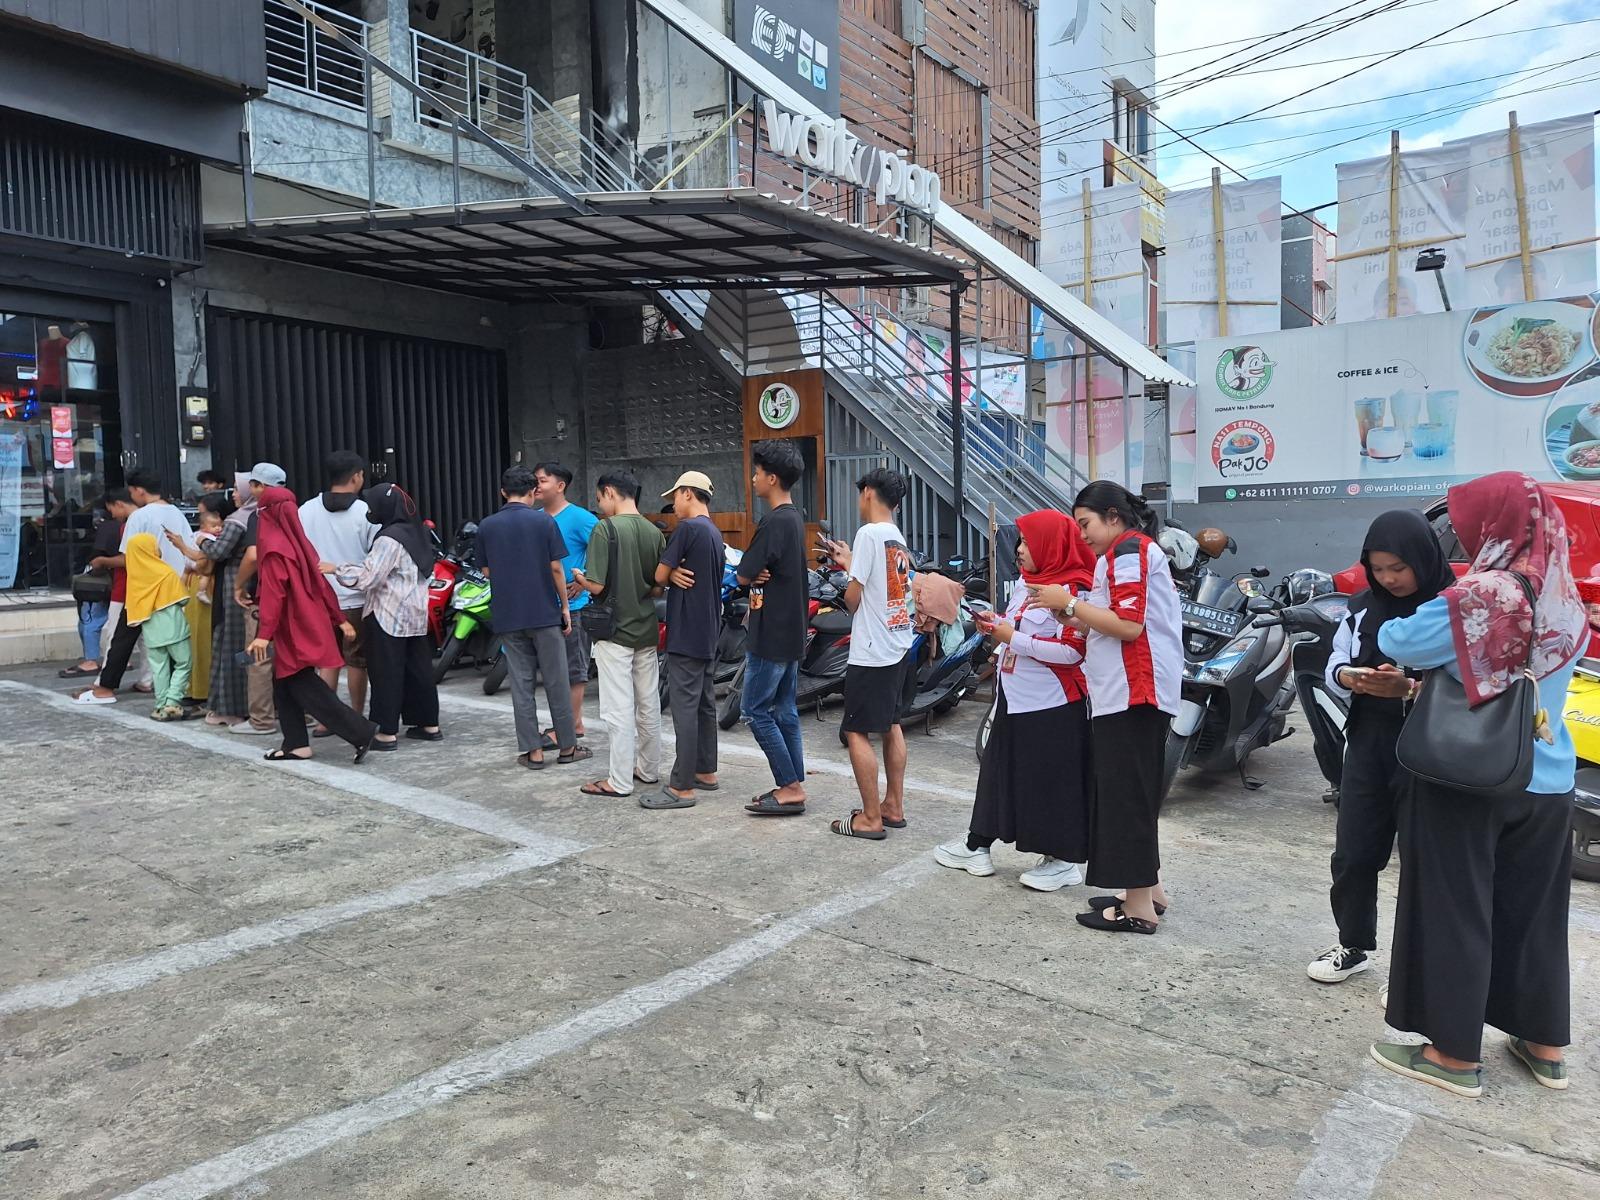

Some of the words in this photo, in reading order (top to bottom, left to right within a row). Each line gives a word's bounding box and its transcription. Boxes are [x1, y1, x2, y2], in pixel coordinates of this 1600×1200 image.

[751, 4, 797, 62] EF
[1337, 368, 1373, 378] COFFEE
[1374, 367, 1382, 375] &
[1383, 366, 1399, 374] ICE
[1213, 427, 1231, 449] NASI
[1232, 420, 1273, 445] TEMPONG
[1218, 458, 1243, 478] Pak
[1239, 490, 1257, 498] +62
[1259, 488, 1277, 497] 811
[1280, 486, 1310, 496] 11111
[1312, 485, 1337, 495] 0707
